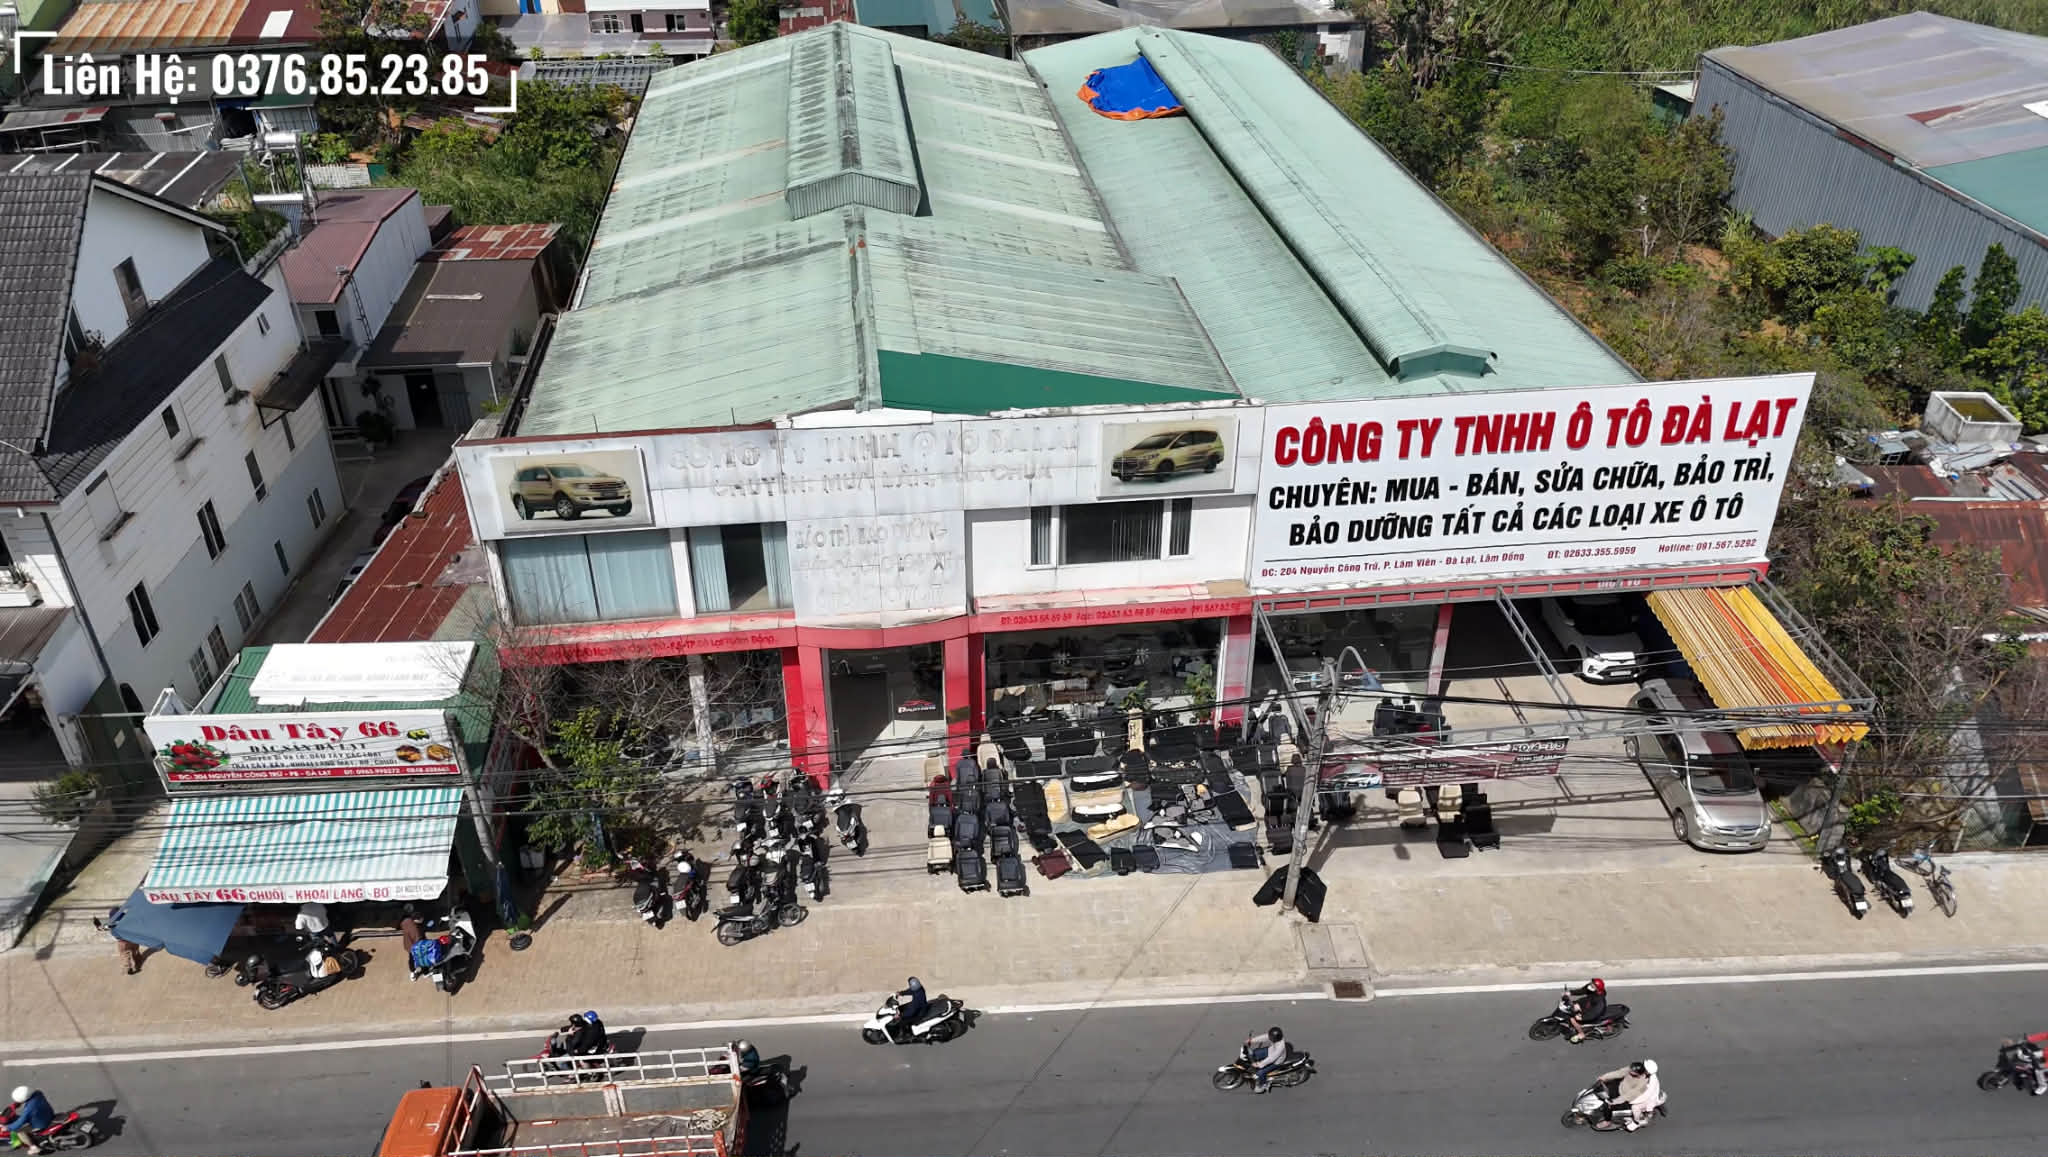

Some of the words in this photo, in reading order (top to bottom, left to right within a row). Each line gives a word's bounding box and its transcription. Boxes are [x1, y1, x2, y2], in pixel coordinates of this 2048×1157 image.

[1274, 416, 1384, 467] CÔNG
[1397, 417, 1442, 459] TY
[1454, 411, 1556, 456] TNHH
[1566, 401, 1593, 450] Ô
[1607, 398, 1652, 448] TÔ
[1660, 395, 1712, 446] ĐÀ
[1723, 398, 1797, 447] LẠT
[1269, 478, 1377, 509] CHUYÊN:
[1385, 476, 1439, 503] MUA
[1466, 468, 1524, 497] BÁN,
[1535, 462, 1584, 493] SỬA
[1593, 461, 1665, 490] CHỮA,
[1673, 454, 1725, 486] BẢO
[1732, 452, 1774, 482] TRÌ,
[1289, 515, 1340, 546] BẢO
[1347, 512, 1433, 542] DƯỠNG
[1442, 504, 1485, 536] TẤT
[1492, 502, 1524, 532] CẢ
[1533, 502, 1582, 531] CÁC
[1589, 503, 1646, 531] LOẠI
[1650, 501, 1684, 524] XE
[1690, 495, 1707, 521] Ô
[1715, 492, 1744, 520] TÔ
[1564, 546, 1636, 558] 02633.355.5959
[1658, 544, 1693, 552] Hotline:
[1262, 568, 1277, 577] ĐC:
[1280, 567, 1297, 576] 204
[1384, 561, 1391, 569] P.
[1394, 559, 1413, 568] Lâm
[1445, 556, 1458, 565] Đà
[1480, 554, 1499, 563] Lâm
[200, 724, 275, 741] Dâu
[279, 722, 349, 743] Tây
[358, 720, 400, 737] 66
[149, 891, 180, 902] DÂU
[216, 888, 246, 900] 66
[295, 889, 329, 900] KHOAI
[333, 888, 363, 899] LANG
